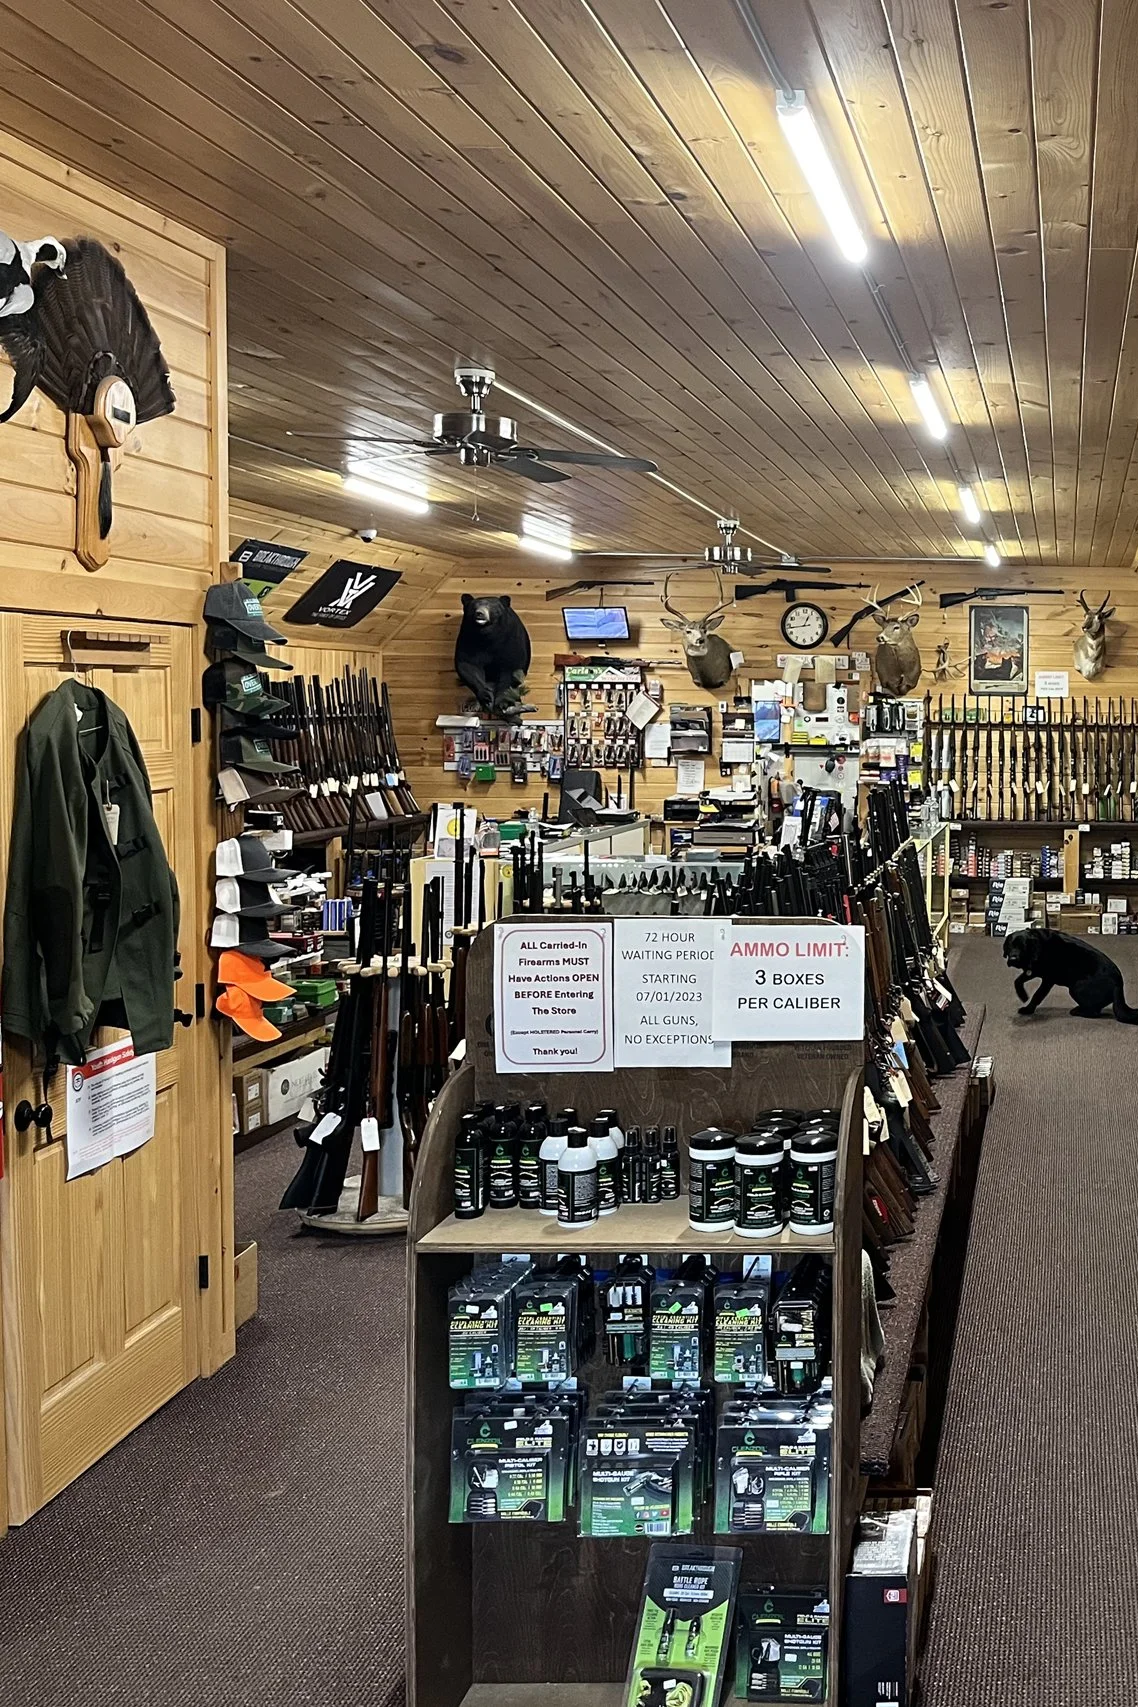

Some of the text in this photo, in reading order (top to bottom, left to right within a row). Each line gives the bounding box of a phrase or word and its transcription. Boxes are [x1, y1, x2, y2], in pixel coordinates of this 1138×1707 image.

[318, 606, 352, 616] VORTEX
[565, 666, 603, 675] Carlsn's
[644, 932, 695, 943] 72 HOUR
[520, 941, 588, 950] ALL Carried-In
[730, 942, 849, 958] AMMO LIMIT:
[621, 950, 673, 960] WAITING
[518, 957, 590, 966] Firearms MUST
[508, 973, 600, 983] Have Actions OPEN
[642, 974, 697, 984] STARTING
[755, 970, 825, 985] 3 BOXES
[514, 990, 594, 1000] BEFORE Entering
[636, 991, 703, 1003] 07/01/2023
[738, 997, 841, 1009] PER CALIBER
[532, 1007, 577, 1015] The Store
[640, 1015, 699, 1027] ALL GUNS,
[624, 1034, 714, 1045] NO EXCEPTIONS
[533, 1048, 578, 1056] Thank you!
[673, 1576, 693, 1584] BATTLE
